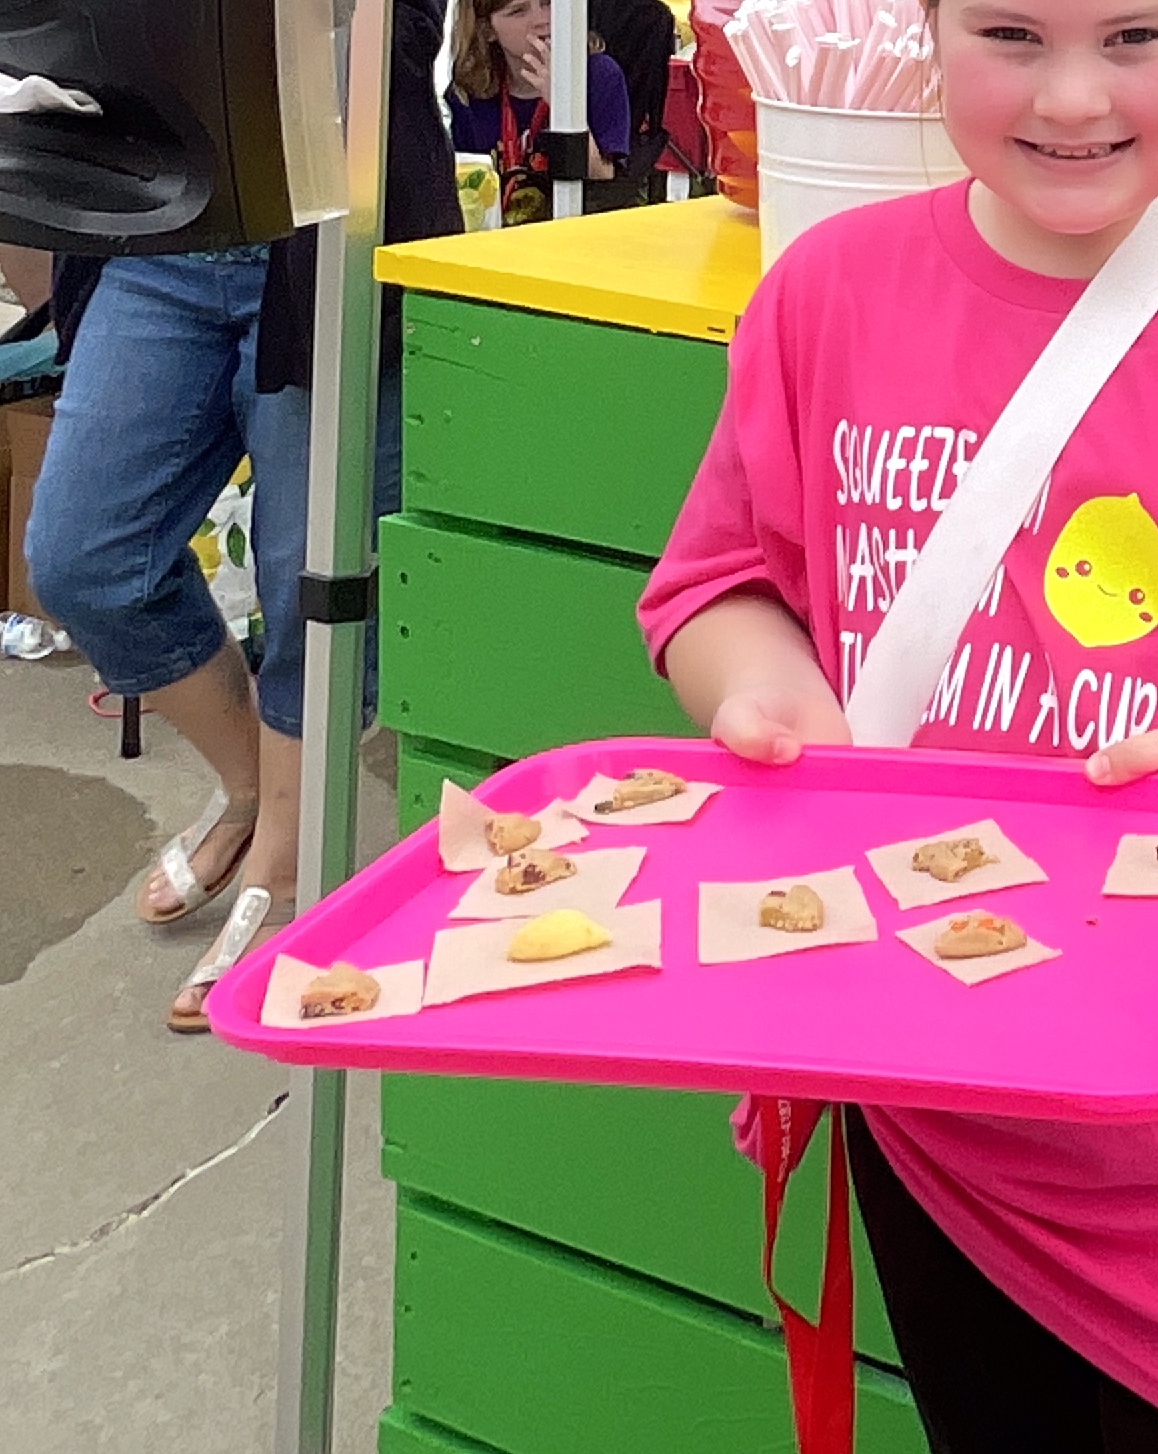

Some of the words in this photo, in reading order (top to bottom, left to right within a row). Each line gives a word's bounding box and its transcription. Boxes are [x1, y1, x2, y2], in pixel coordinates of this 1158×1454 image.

[972, 641, 1032, 732] IN
[1028, 651, 1061, 748] A
[1066, 667, 1158, 753] CUP
